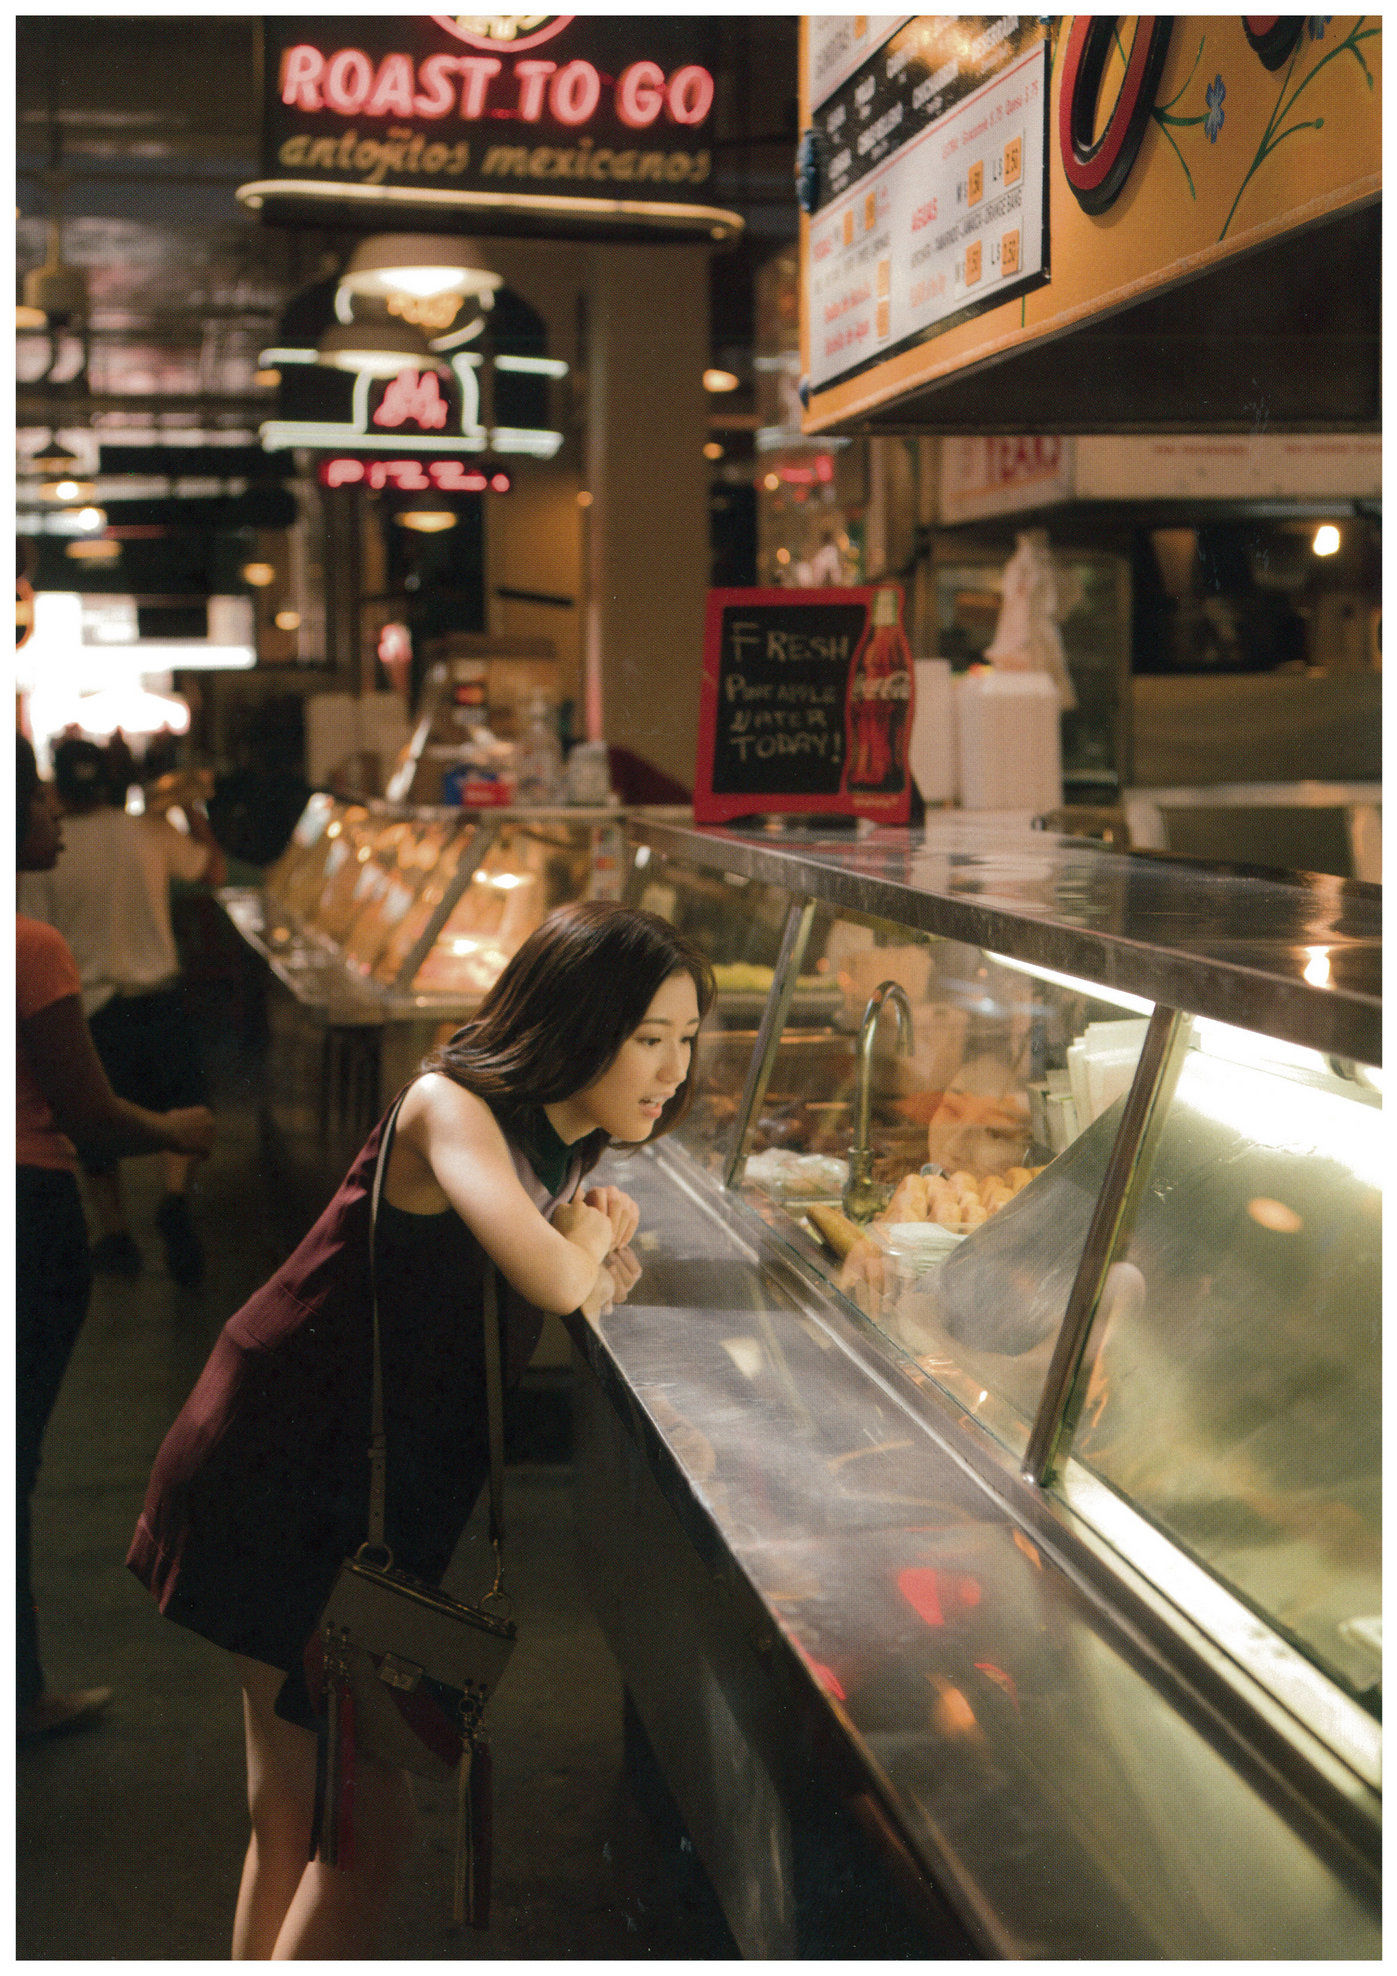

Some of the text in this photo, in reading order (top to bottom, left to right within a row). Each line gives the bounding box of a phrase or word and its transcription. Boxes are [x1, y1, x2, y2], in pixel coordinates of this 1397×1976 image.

[280, 44, 715, 127] ROAST TO GO
[480, 136, 713, 183] mexicanos
[327, 458, 511, 493] PIZZ
[730, 620, 850, 663] FRESH
[729, 730, 843, 765] TODAY!
